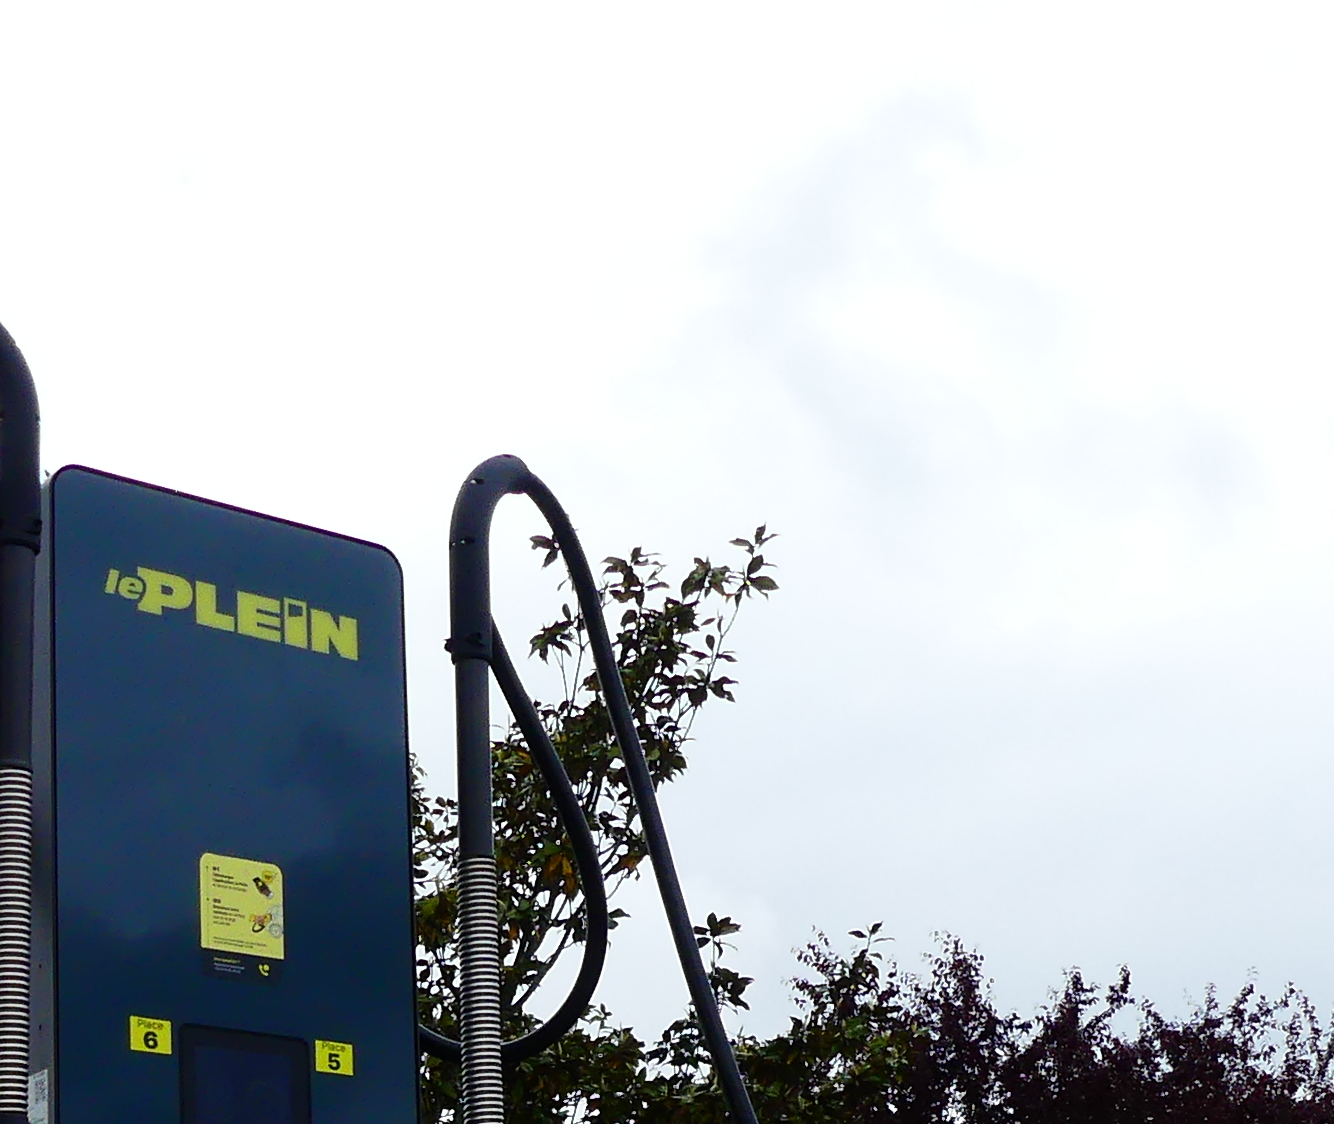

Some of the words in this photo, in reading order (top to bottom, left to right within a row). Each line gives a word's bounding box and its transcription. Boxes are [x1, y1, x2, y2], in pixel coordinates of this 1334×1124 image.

[137, 1019, 164, 1031] Place
[143, 1030, 159, 1050] 6
[327, 1052, 341, 1071] 5
